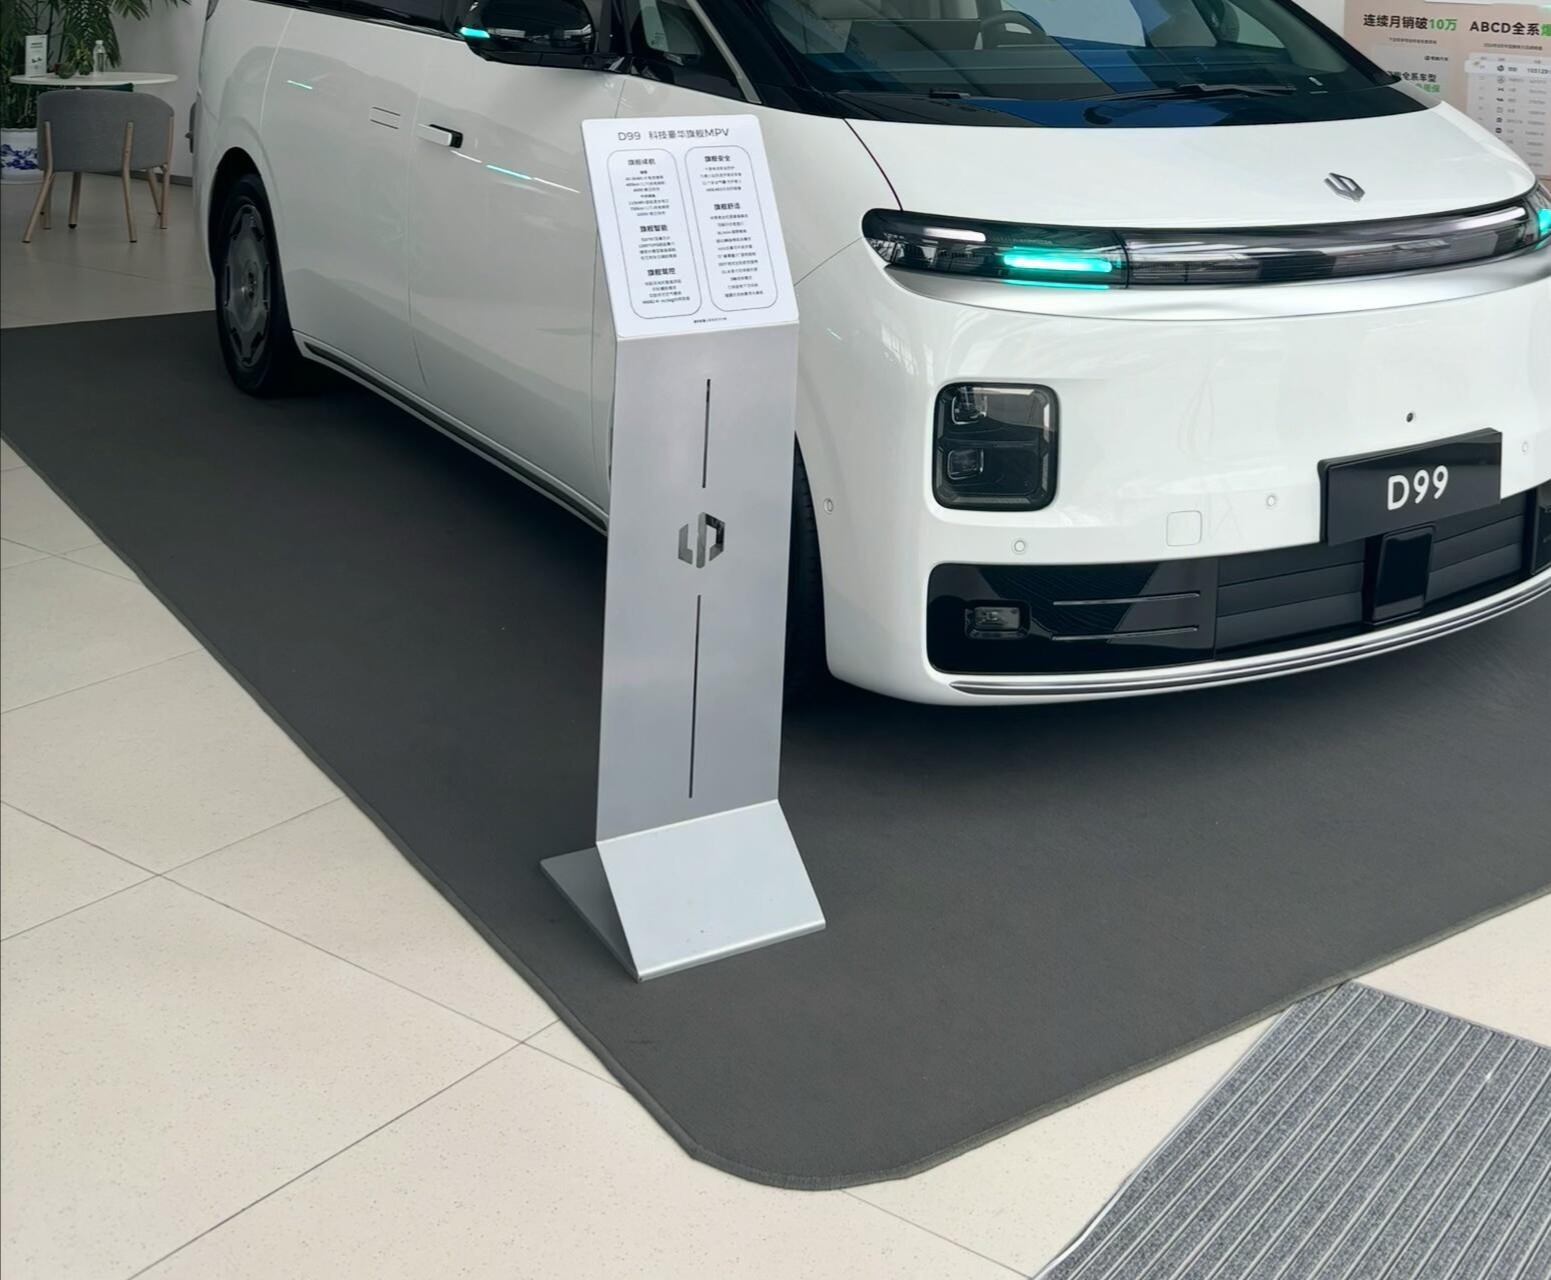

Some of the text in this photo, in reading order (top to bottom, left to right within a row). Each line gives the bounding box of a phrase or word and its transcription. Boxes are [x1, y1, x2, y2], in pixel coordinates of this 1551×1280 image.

[1363, 14, 1458, 31] 连续月销破10万
[617, 131, 641, 141] D99
[1387, 465, 1449, 511] D99
